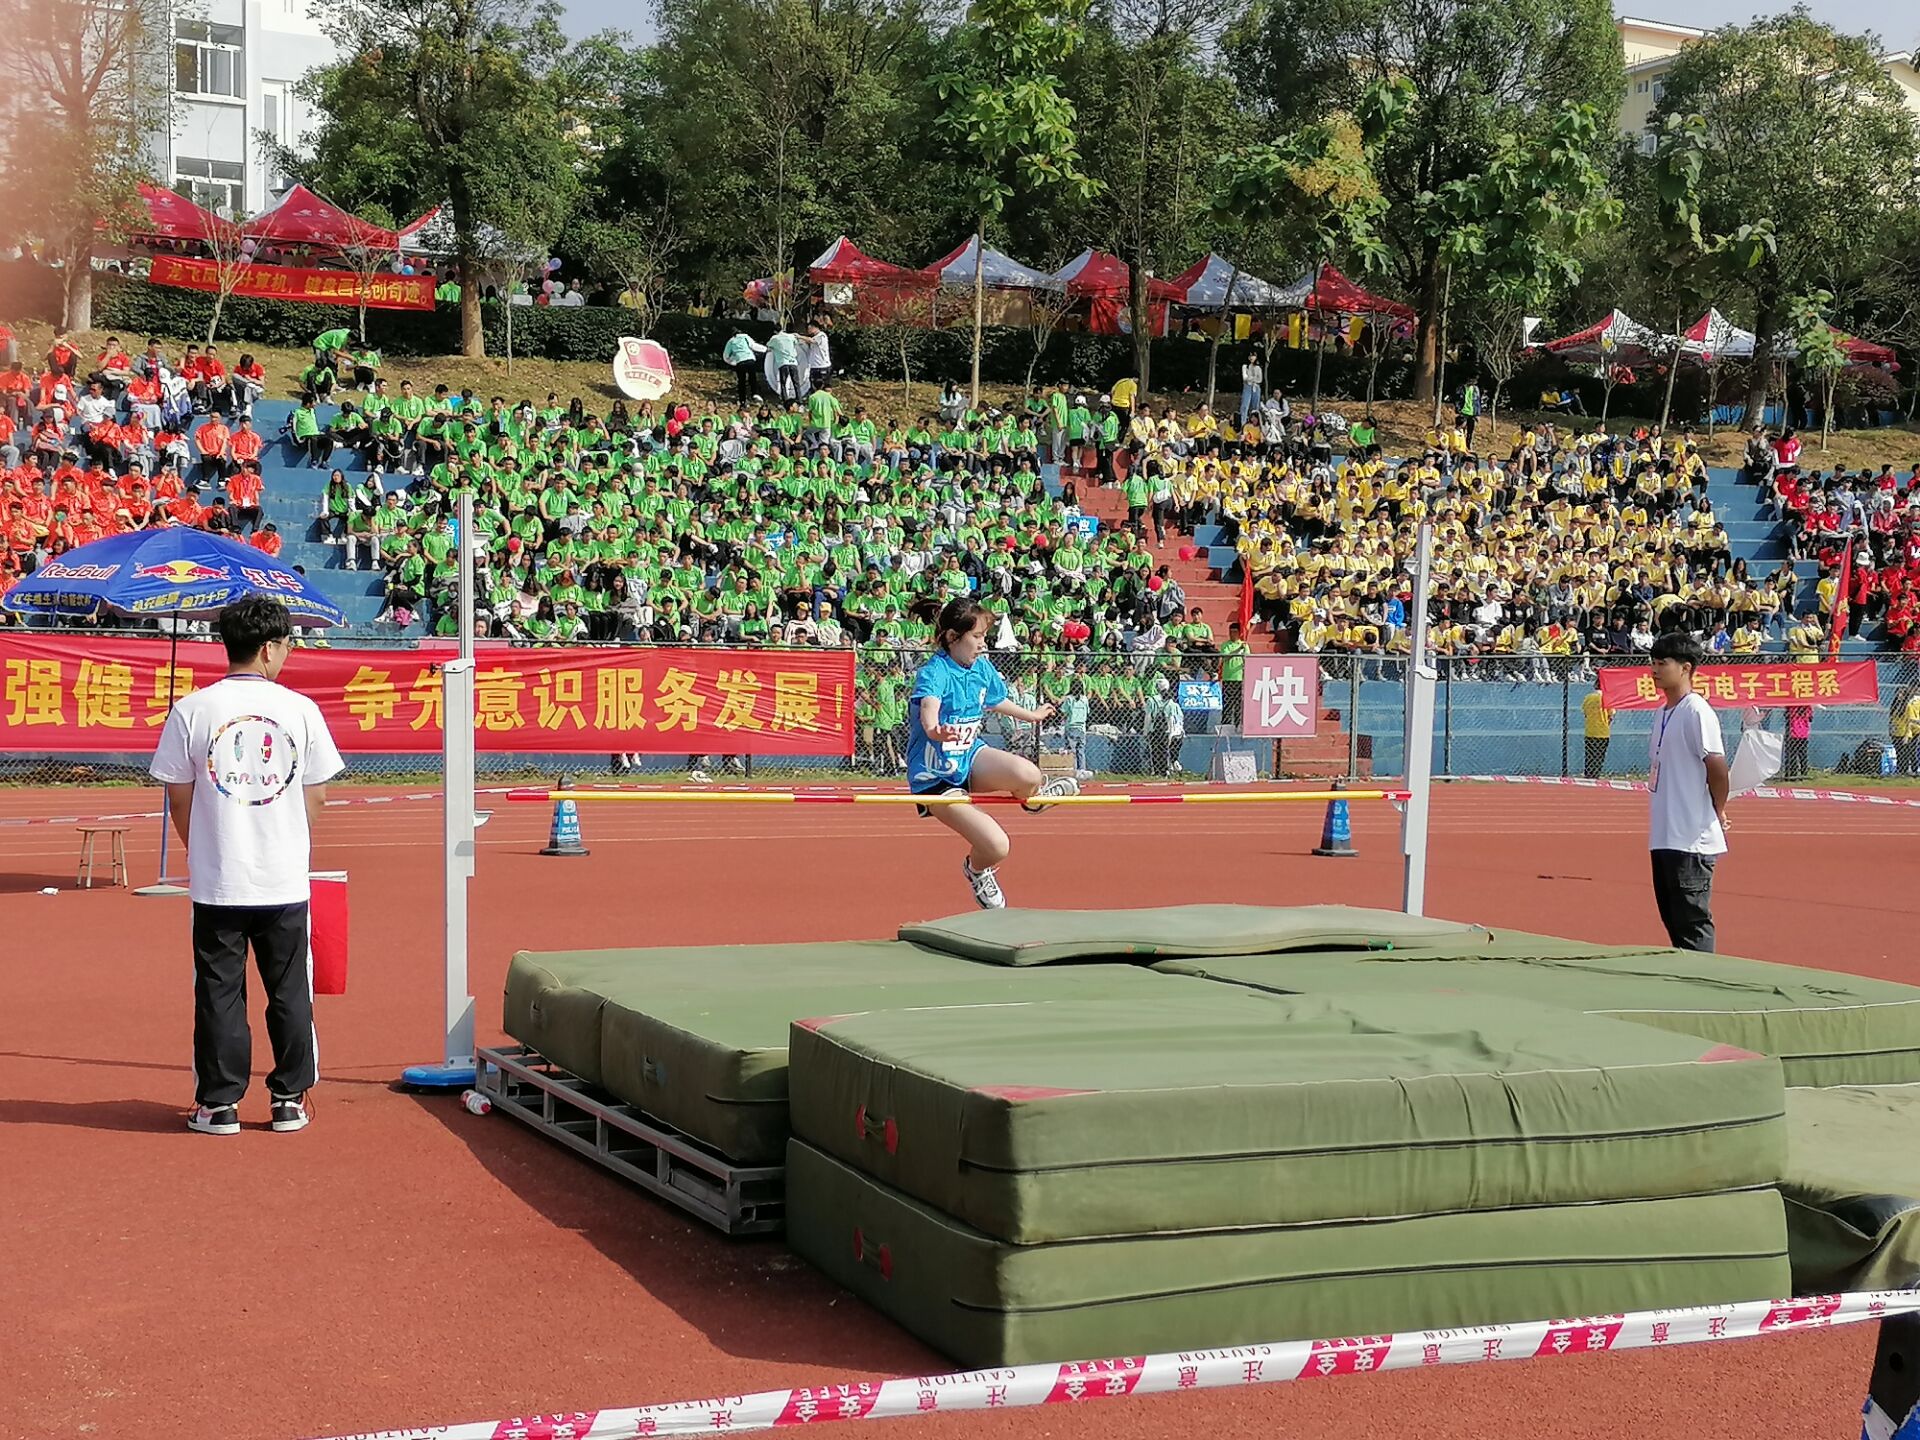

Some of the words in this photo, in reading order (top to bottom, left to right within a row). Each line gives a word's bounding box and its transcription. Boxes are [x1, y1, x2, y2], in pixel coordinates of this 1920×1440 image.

[1253, 666, 1309, 728] 快
[1636, 669, 1841, 702] 电与电子工程系
[1552, 1327, 1607, 1354] 安全
[1316, 1348, 1375, 1376] 安全
[800, 1382, 872, 1400] SAFE
[918, 1370, 1016, 1388] CAUTION
[1065, 1372, 1127, 1400] 安全
[796, 1394, 862, 1423] 安全
